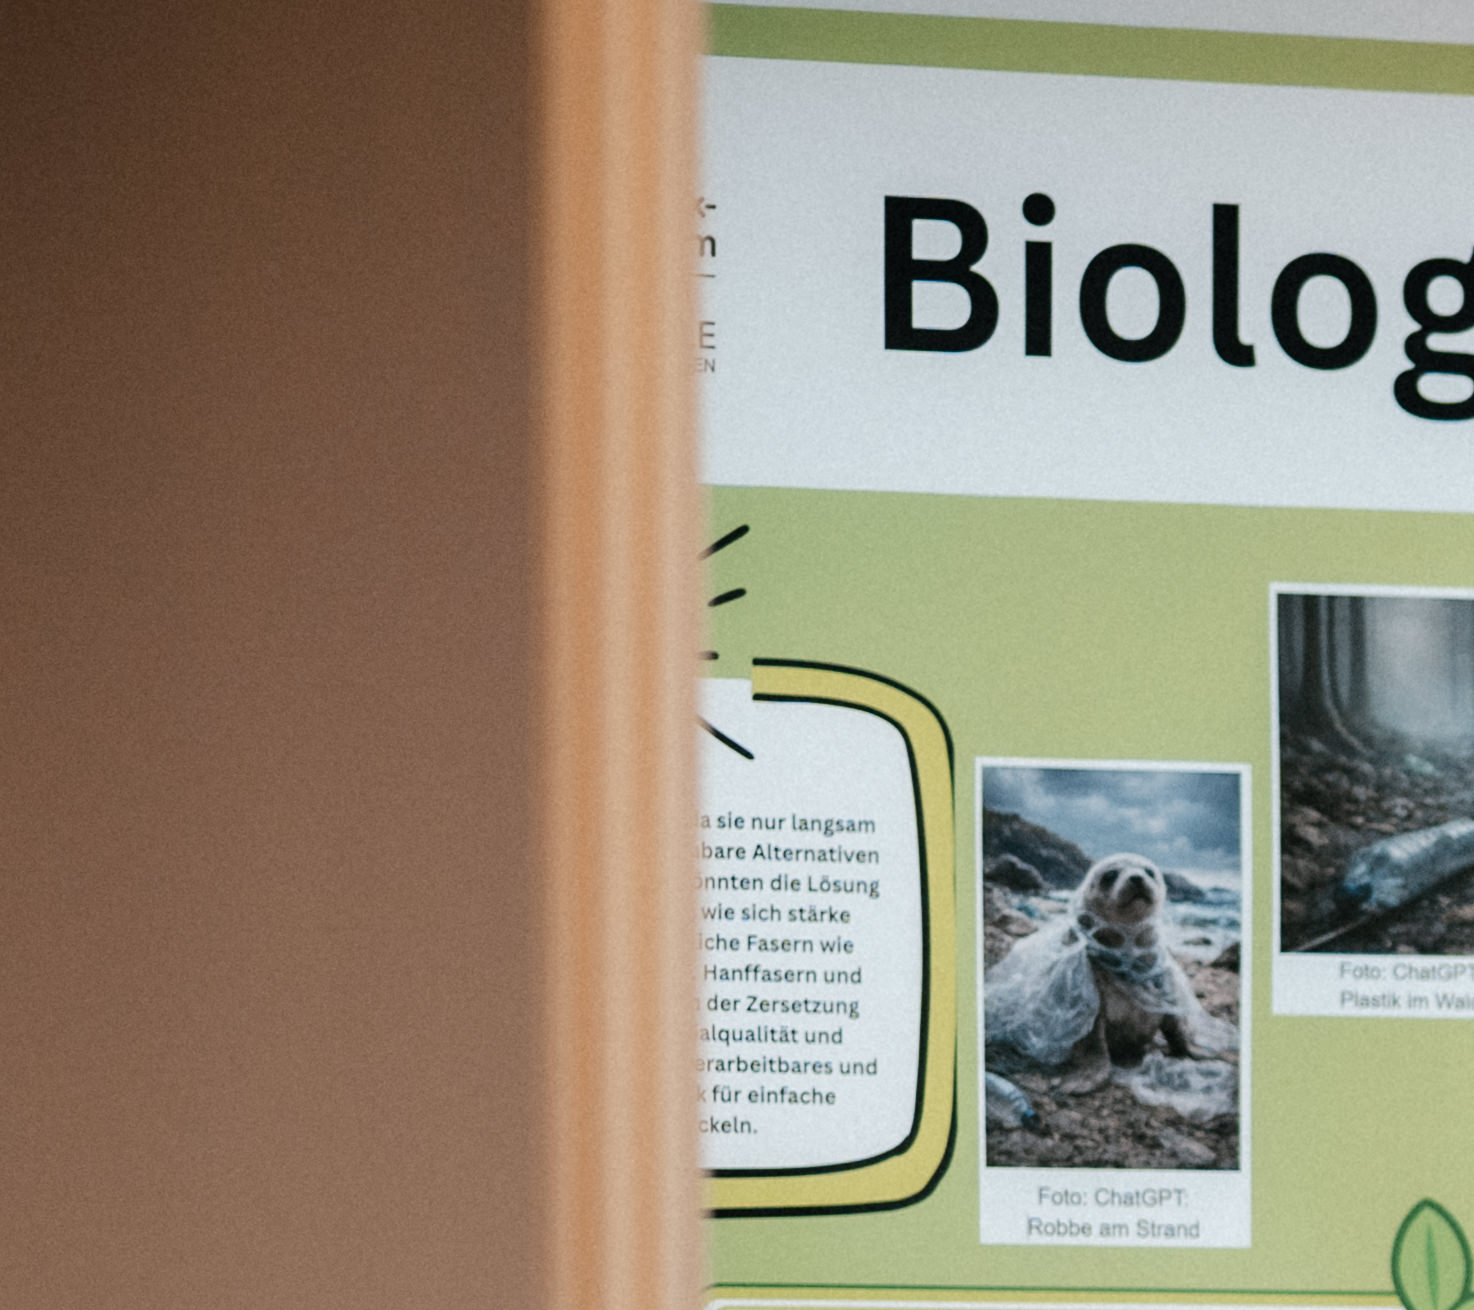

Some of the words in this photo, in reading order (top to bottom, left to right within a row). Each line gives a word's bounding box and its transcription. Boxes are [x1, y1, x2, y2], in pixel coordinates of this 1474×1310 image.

[716, 811, 745, 830] sie
[751, 816, 786, 831] nur
[791, 814, 876, 839] langsam
[752, 843, 879, 864] Alternativen
[769, 874, 801, 892] die
[807, 875, 880, 900] Lösung
[701, 903, 735, 921] wie
[741, 903, 782, 922] sich
[788, 905, 851, 924] stärke
[746, 934, 814, 954] Fasern
[819, 936, 854, 954] wie
[702, 963, 817, 984] Hanffasern
[823, 967, 862, 985] und
[705, 995, 741, 1012] der
[746, 995, 860, 1019] Zersetzung
[1339, 990, 1401, 1009] Plastik
[1406, 994, 1429, 1009] im
[711, 1085, 742, 1103] für
[747, 1085, 836, 1105] einfache
[1026, 1217, 1093, 1237] Robbe
[1098, 1222, 1130, 1238] am
[1136, 1219, 1200, 1239] Strand
